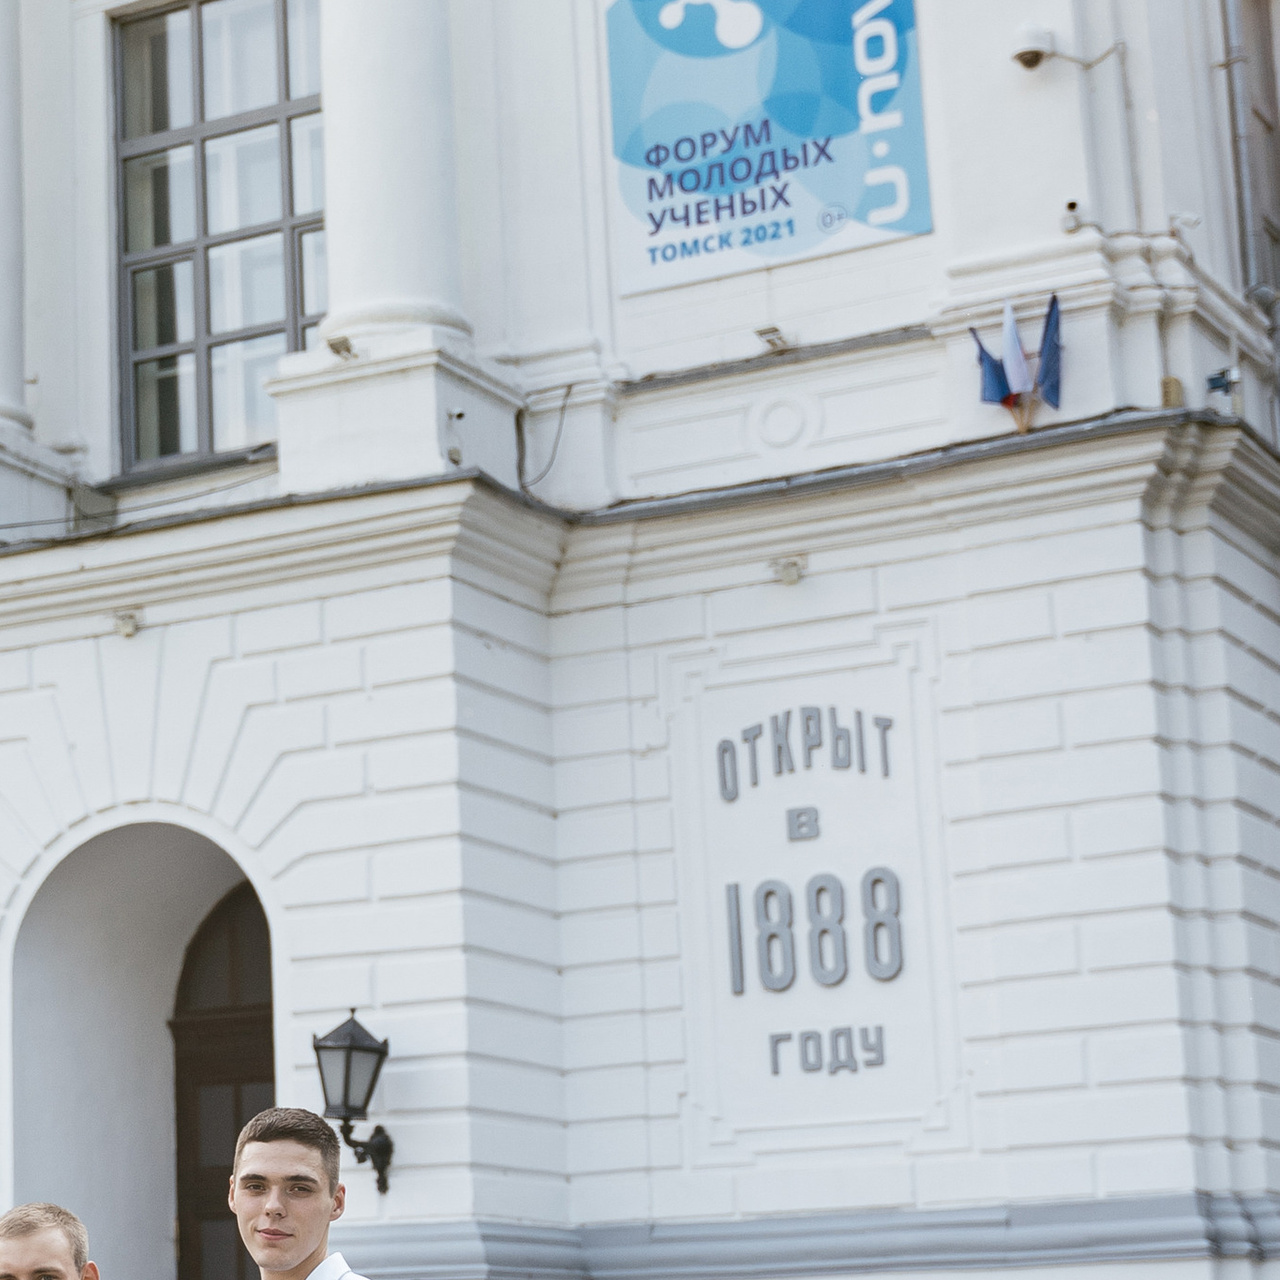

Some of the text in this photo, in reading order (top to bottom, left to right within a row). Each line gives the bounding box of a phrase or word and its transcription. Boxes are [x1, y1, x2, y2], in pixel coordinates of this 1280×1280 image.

[645, 119, 772, 168] ФОРУМ
[647, 135, 834, 202] МОЛОДЫХ
[647, 182, 791, 236] УЧЕНЫХ
[648, 218, 796, 265] ТОМСК 2021
[717, 706, 894, 803] ОТКРЫТ
[786, 807, 821, 842] В
[726, 866, 904, 996] 1888
[769, 1025, 885, 1076] ГОДУ
